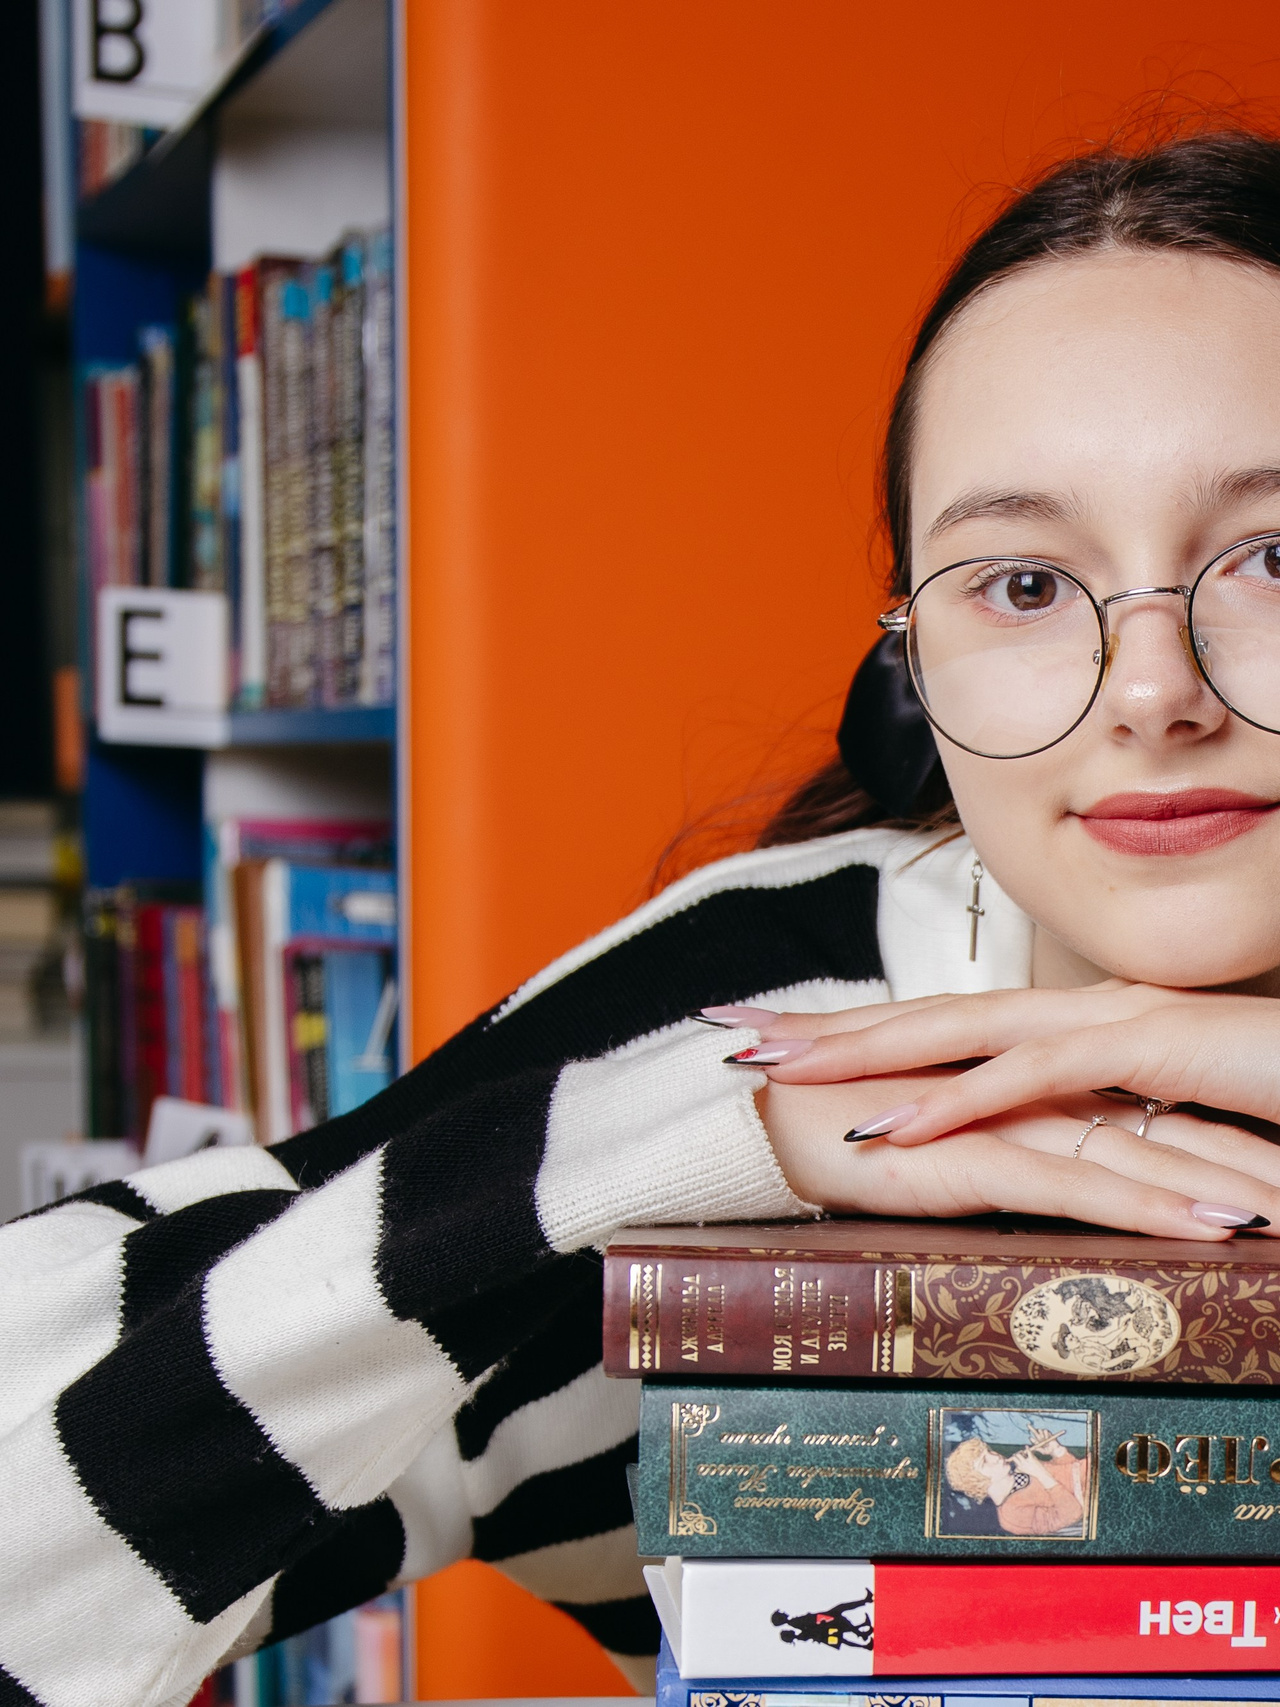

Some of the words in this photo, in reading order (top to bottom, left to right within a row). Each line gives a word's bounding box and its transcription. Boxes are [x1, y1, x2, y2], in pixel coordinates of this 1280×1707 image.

[120, 609, 164, 706] Е
[681, 1273, 700, 1362] ДЖЕРАЛЬД
[707, 1284, 725, 1353] ДАРРЕЛЛ
[774, 1267, 794, 1330] СЕМЬЯ
[801, 1279, 821, 1350] ДРУГИЕ
[828, 1295, 848, 1351] ЗВЕРИ
[773, 1334, 792, 1371] МОЯ
[800, 1353, 819, 1364] И
[720, 1422, 792, 1445] гусями
[803, 1424, 886, 1447] дикими
[887, 1433, 899, 1446] с
[697, 1463, 778, 1492] Нильса
[734, 1488, 875, 1526] Удивительное
[1139, 1600, 1267, 1648] Твен
